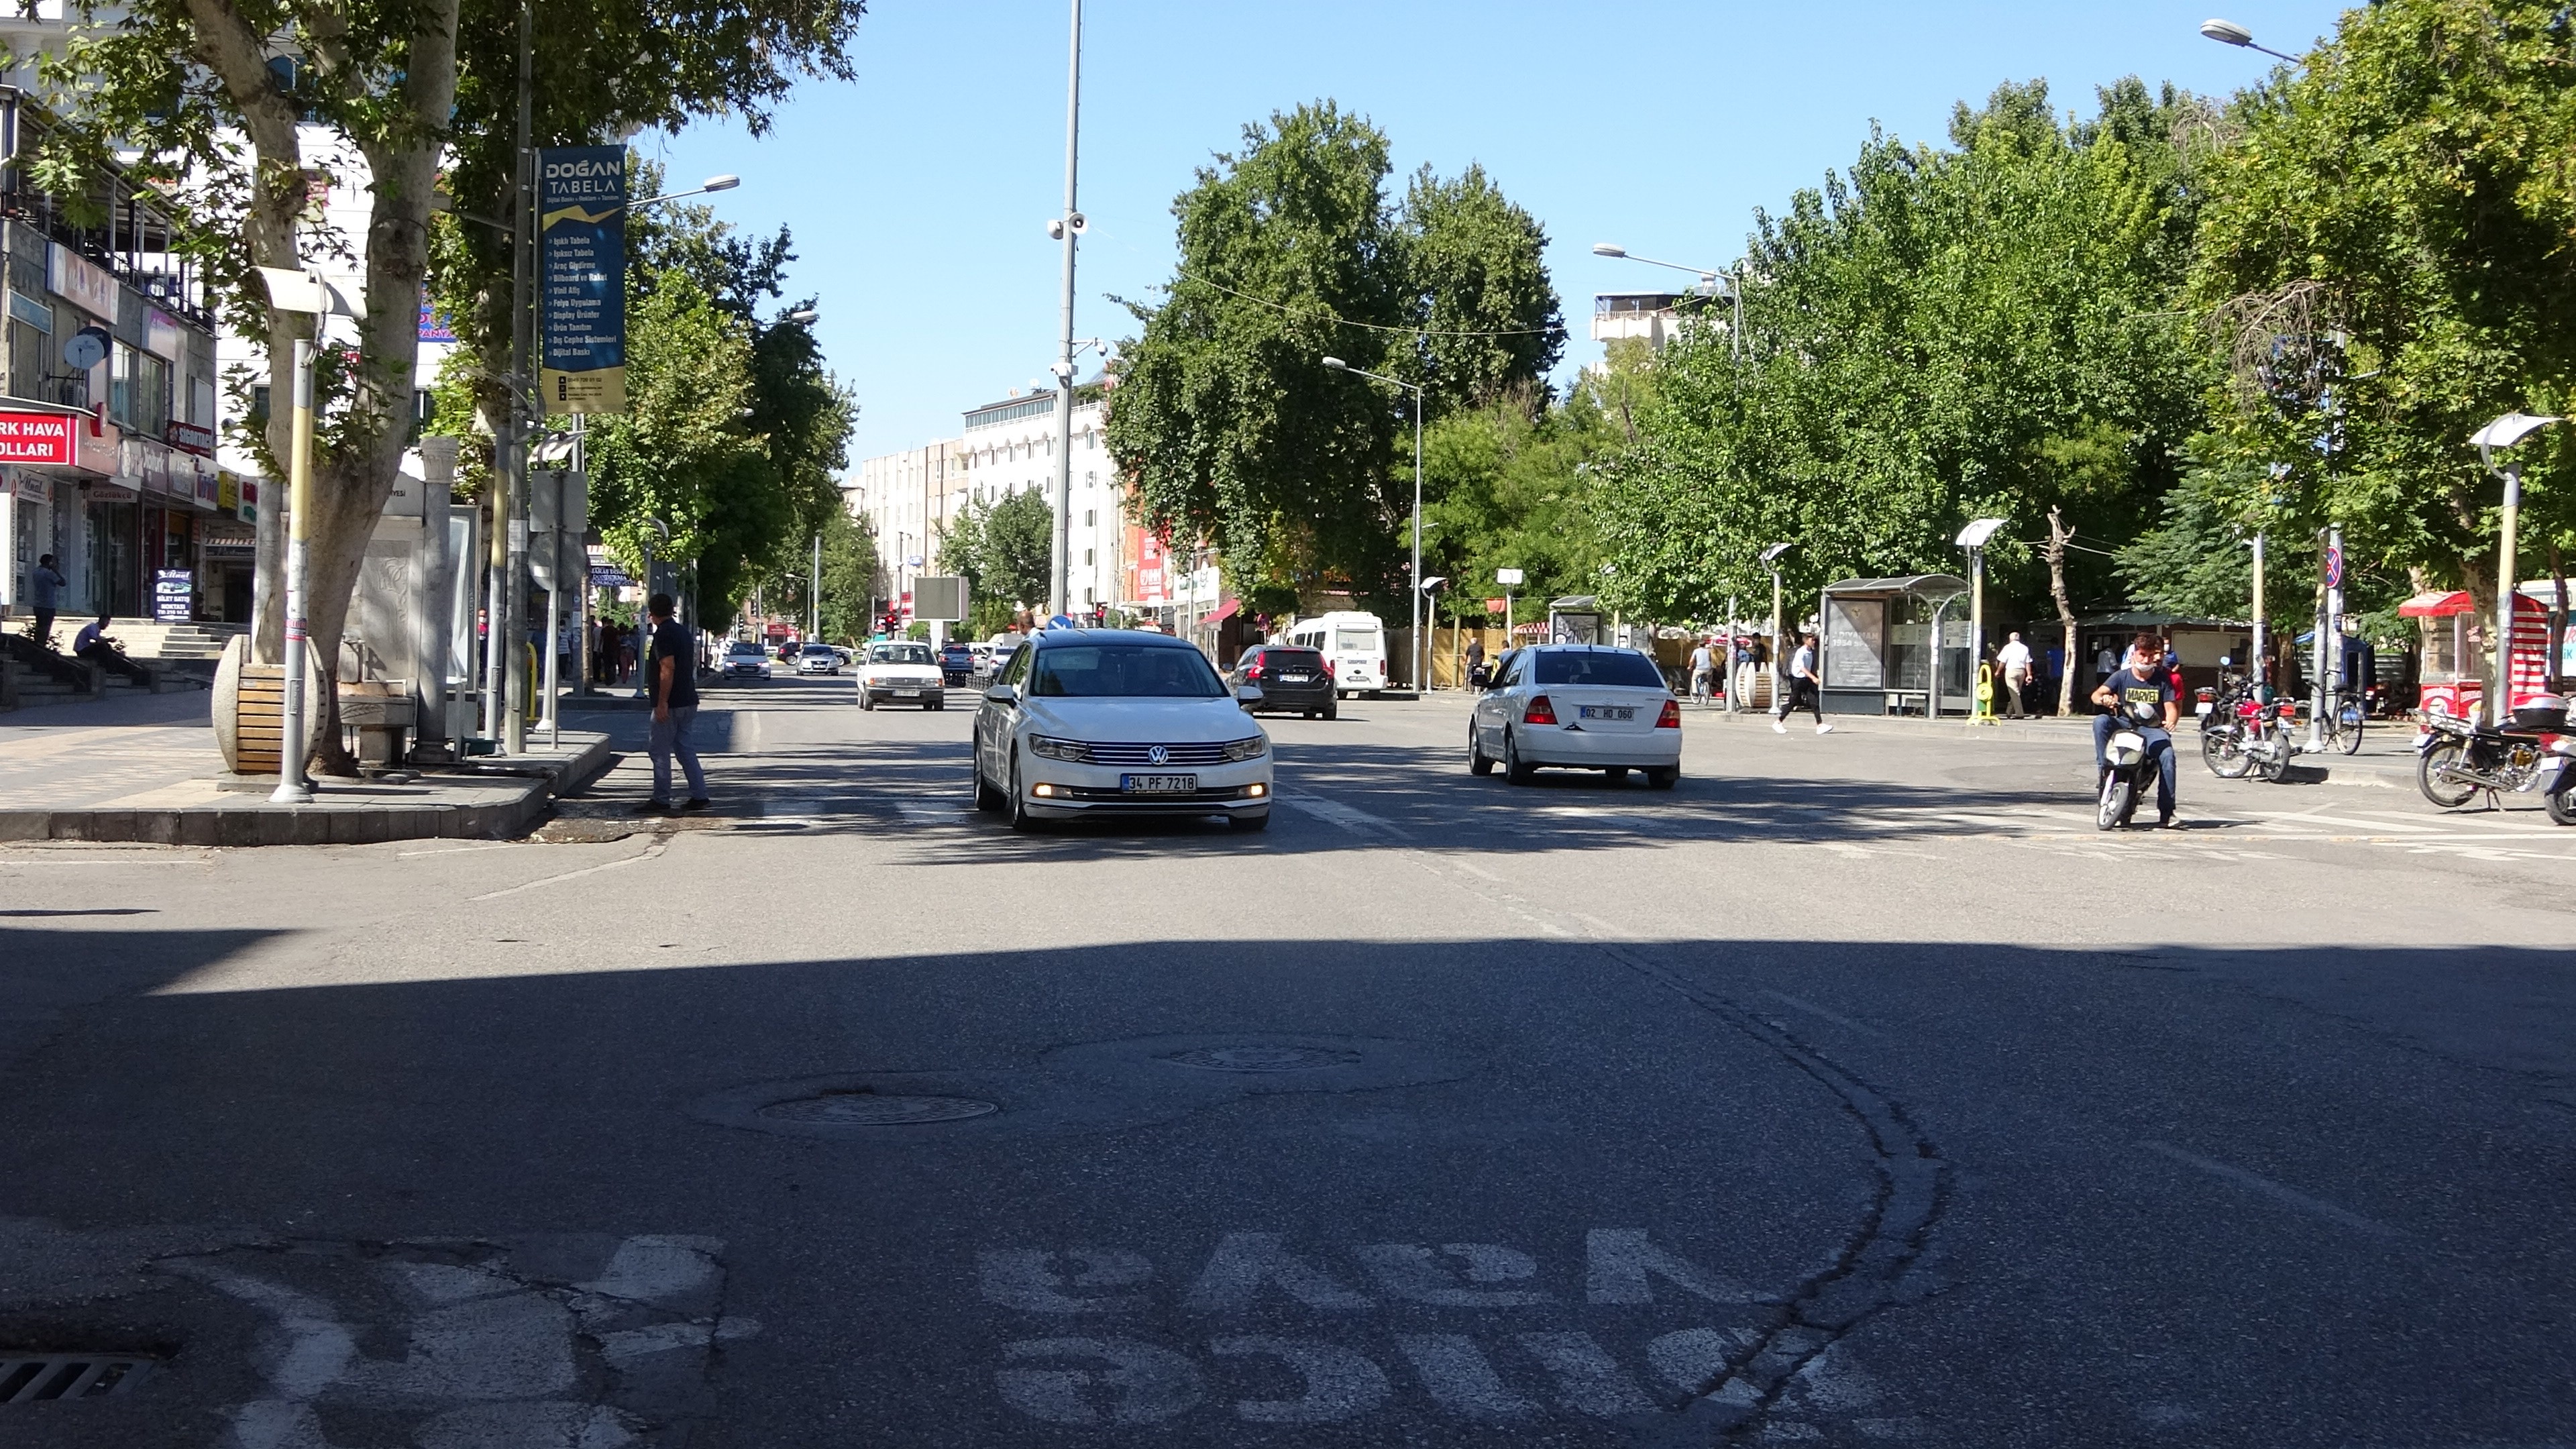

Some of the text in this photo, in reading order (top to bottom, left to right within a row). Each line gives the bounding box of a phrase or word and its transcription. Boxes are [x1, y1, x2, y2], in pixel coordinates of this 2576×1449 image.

[546, 160, 621, 178] DOĞAN
[550, 180, 616, 194] TABELA
[570, 236, 590, 244] Tabela
[574, 249, 594, 257] Tabela
[553, 262, 568, 271] Araç
[553, 286, 581, 295] Vinil Afiş
[553, 299, 602, 308] Folyo Uygulama
[553, 309, 600, 320] Display Ürünler
[553, 322, 568, 331] Ürün
[553, 335, 616, 345] Dış Cephe Sistemleri
[23, 423, 65, 436] HAVA
[93, 490, 131, 499] Gözlükçü
[2127, 690, 2158, 702] MARVEL
[1586, 709, 1595, 717] 02
[1618, 710, 1632, 718] 060
[1130, 777, 1194, 789] 34 PF 7218
